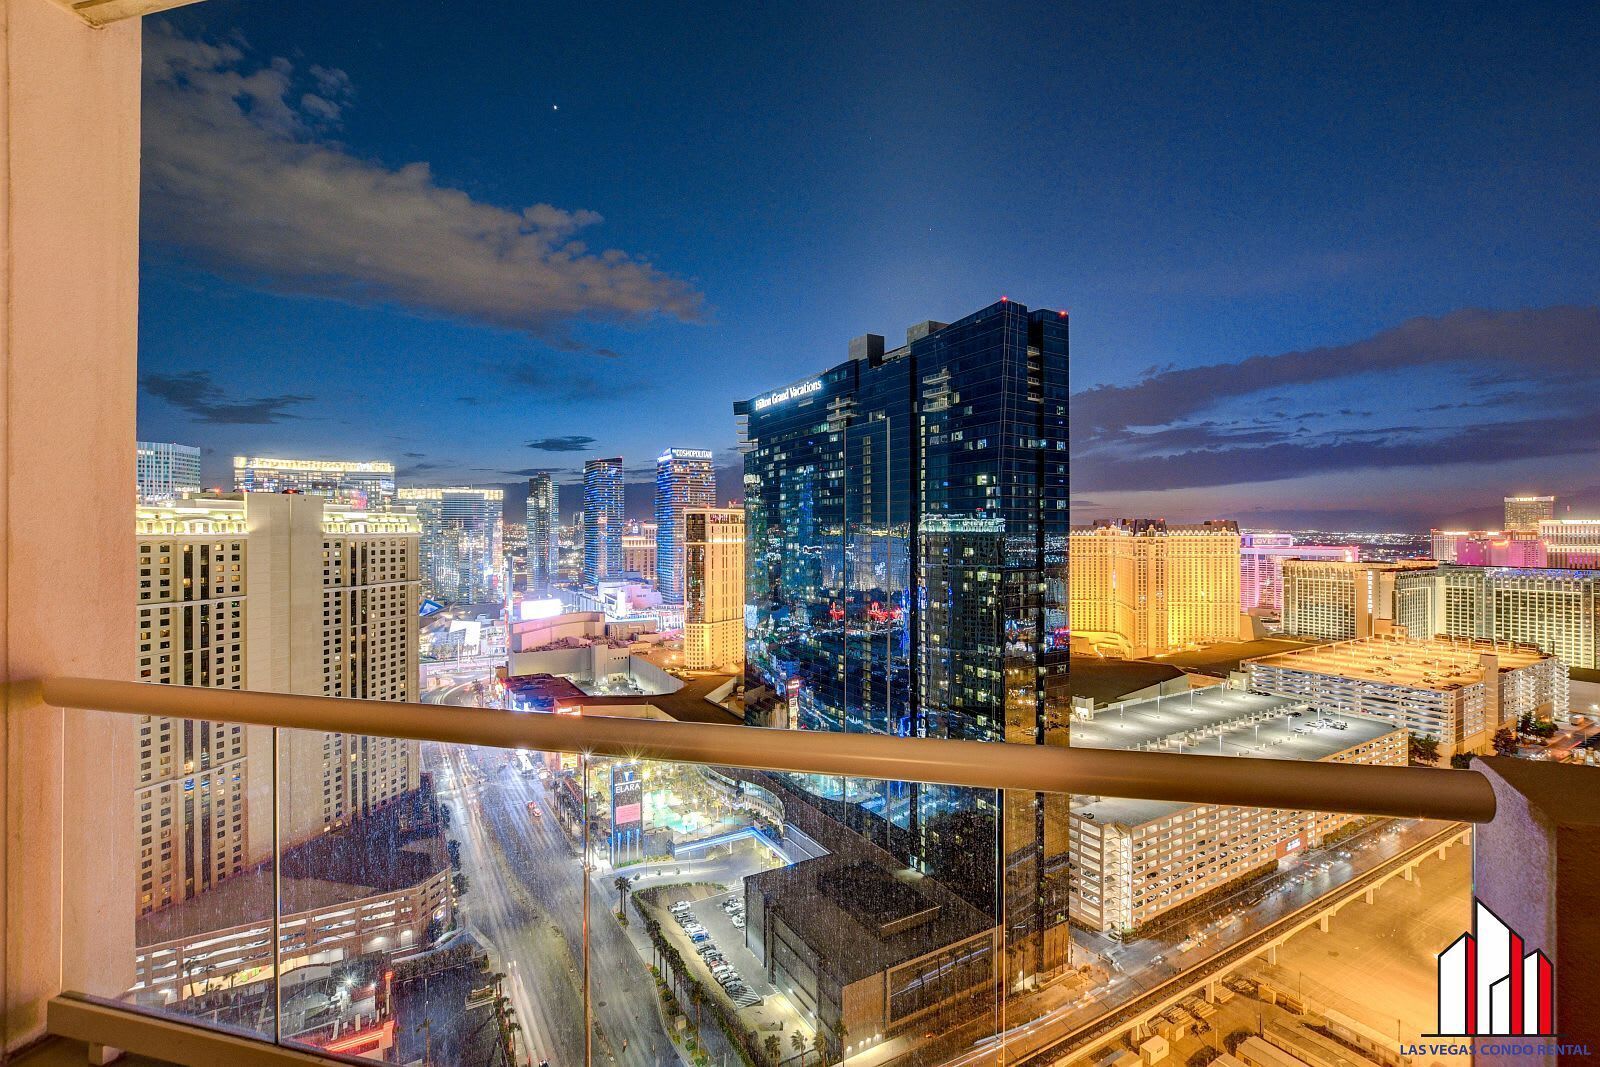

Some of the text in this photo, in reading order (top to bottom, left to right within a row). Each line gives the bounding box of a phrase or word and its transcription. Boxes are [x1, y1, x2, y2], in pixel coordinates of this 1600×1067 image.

[755, 380, 822, 411] Hilton Grand Vacations
[676, 449, 712, 459] COSMOPOLITAN
[615, 783, 641, 794] ELARA
